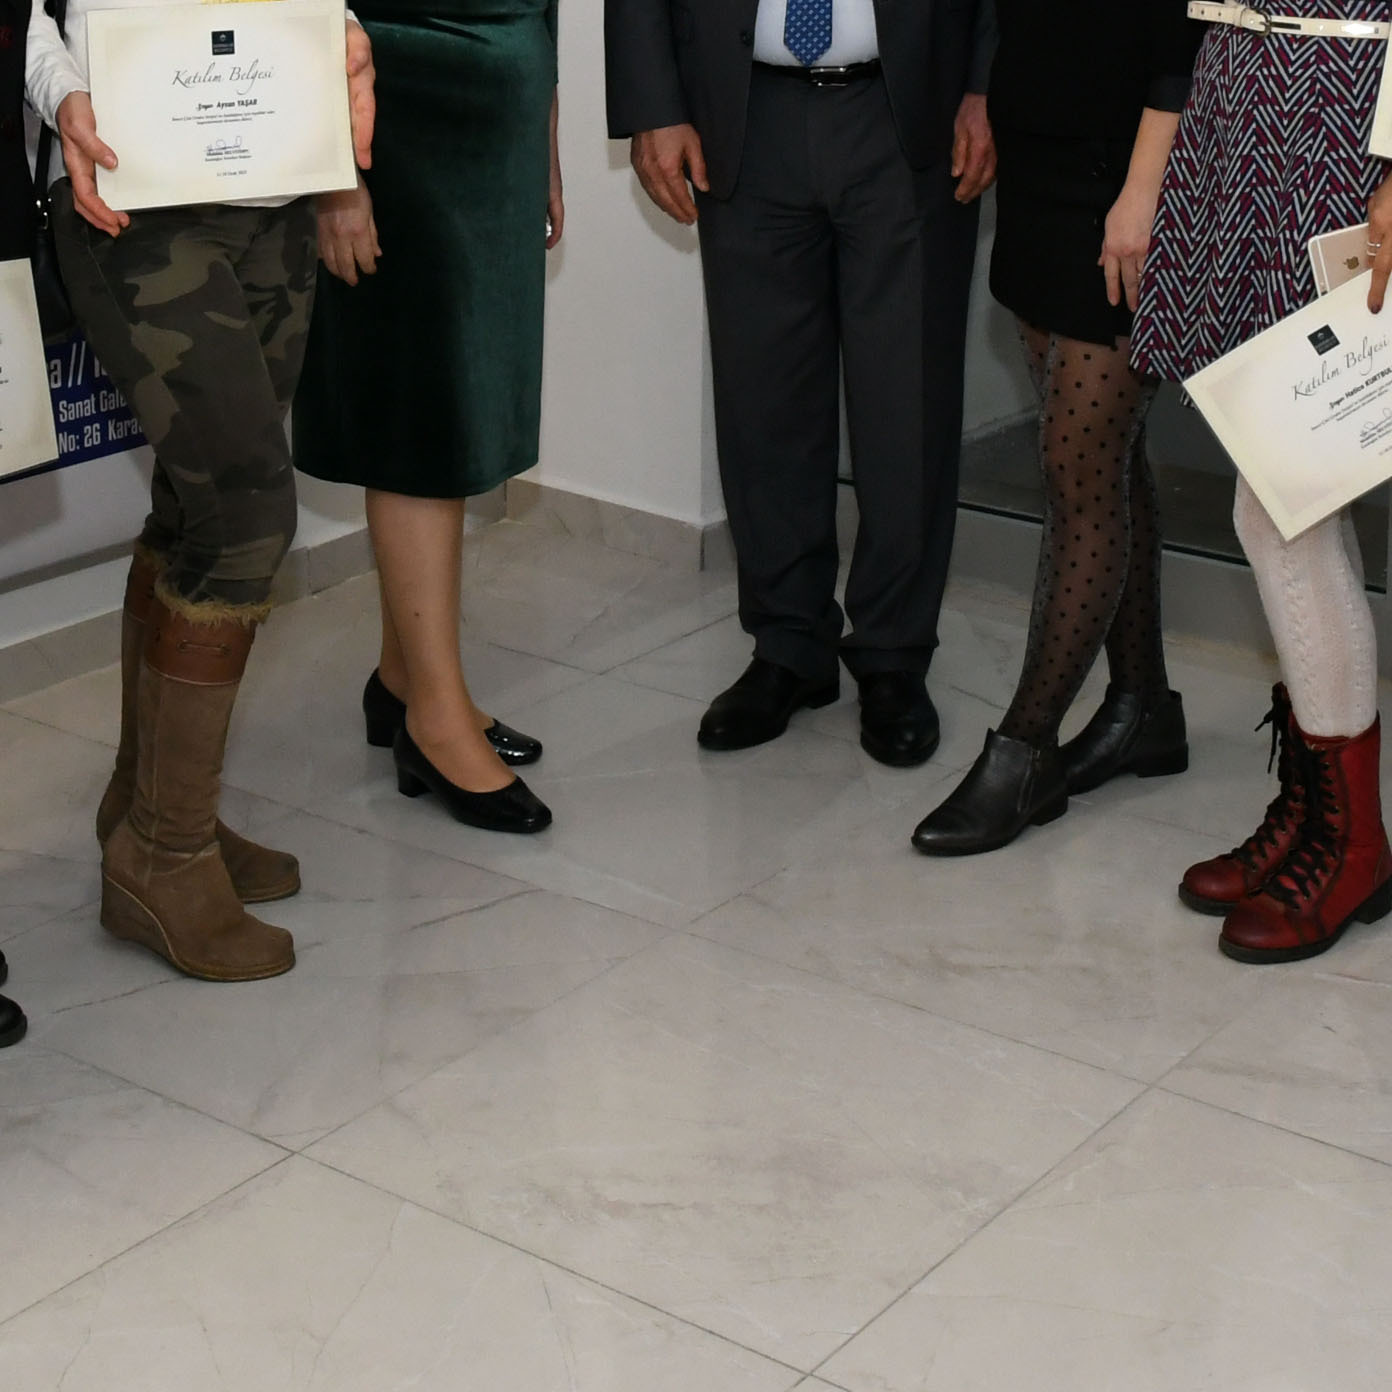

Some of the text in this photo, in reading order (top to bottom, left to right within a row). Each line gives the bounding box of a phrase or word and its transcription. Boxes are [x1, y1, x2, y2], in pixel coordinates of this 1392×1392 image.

[229, 59, 274, 95] Belgesi
[1344, 335, 1388, 376] Belgesi
[59, 393, 96, 423] Sanat
[58, 418, 143, 454] No: 26 Kara
